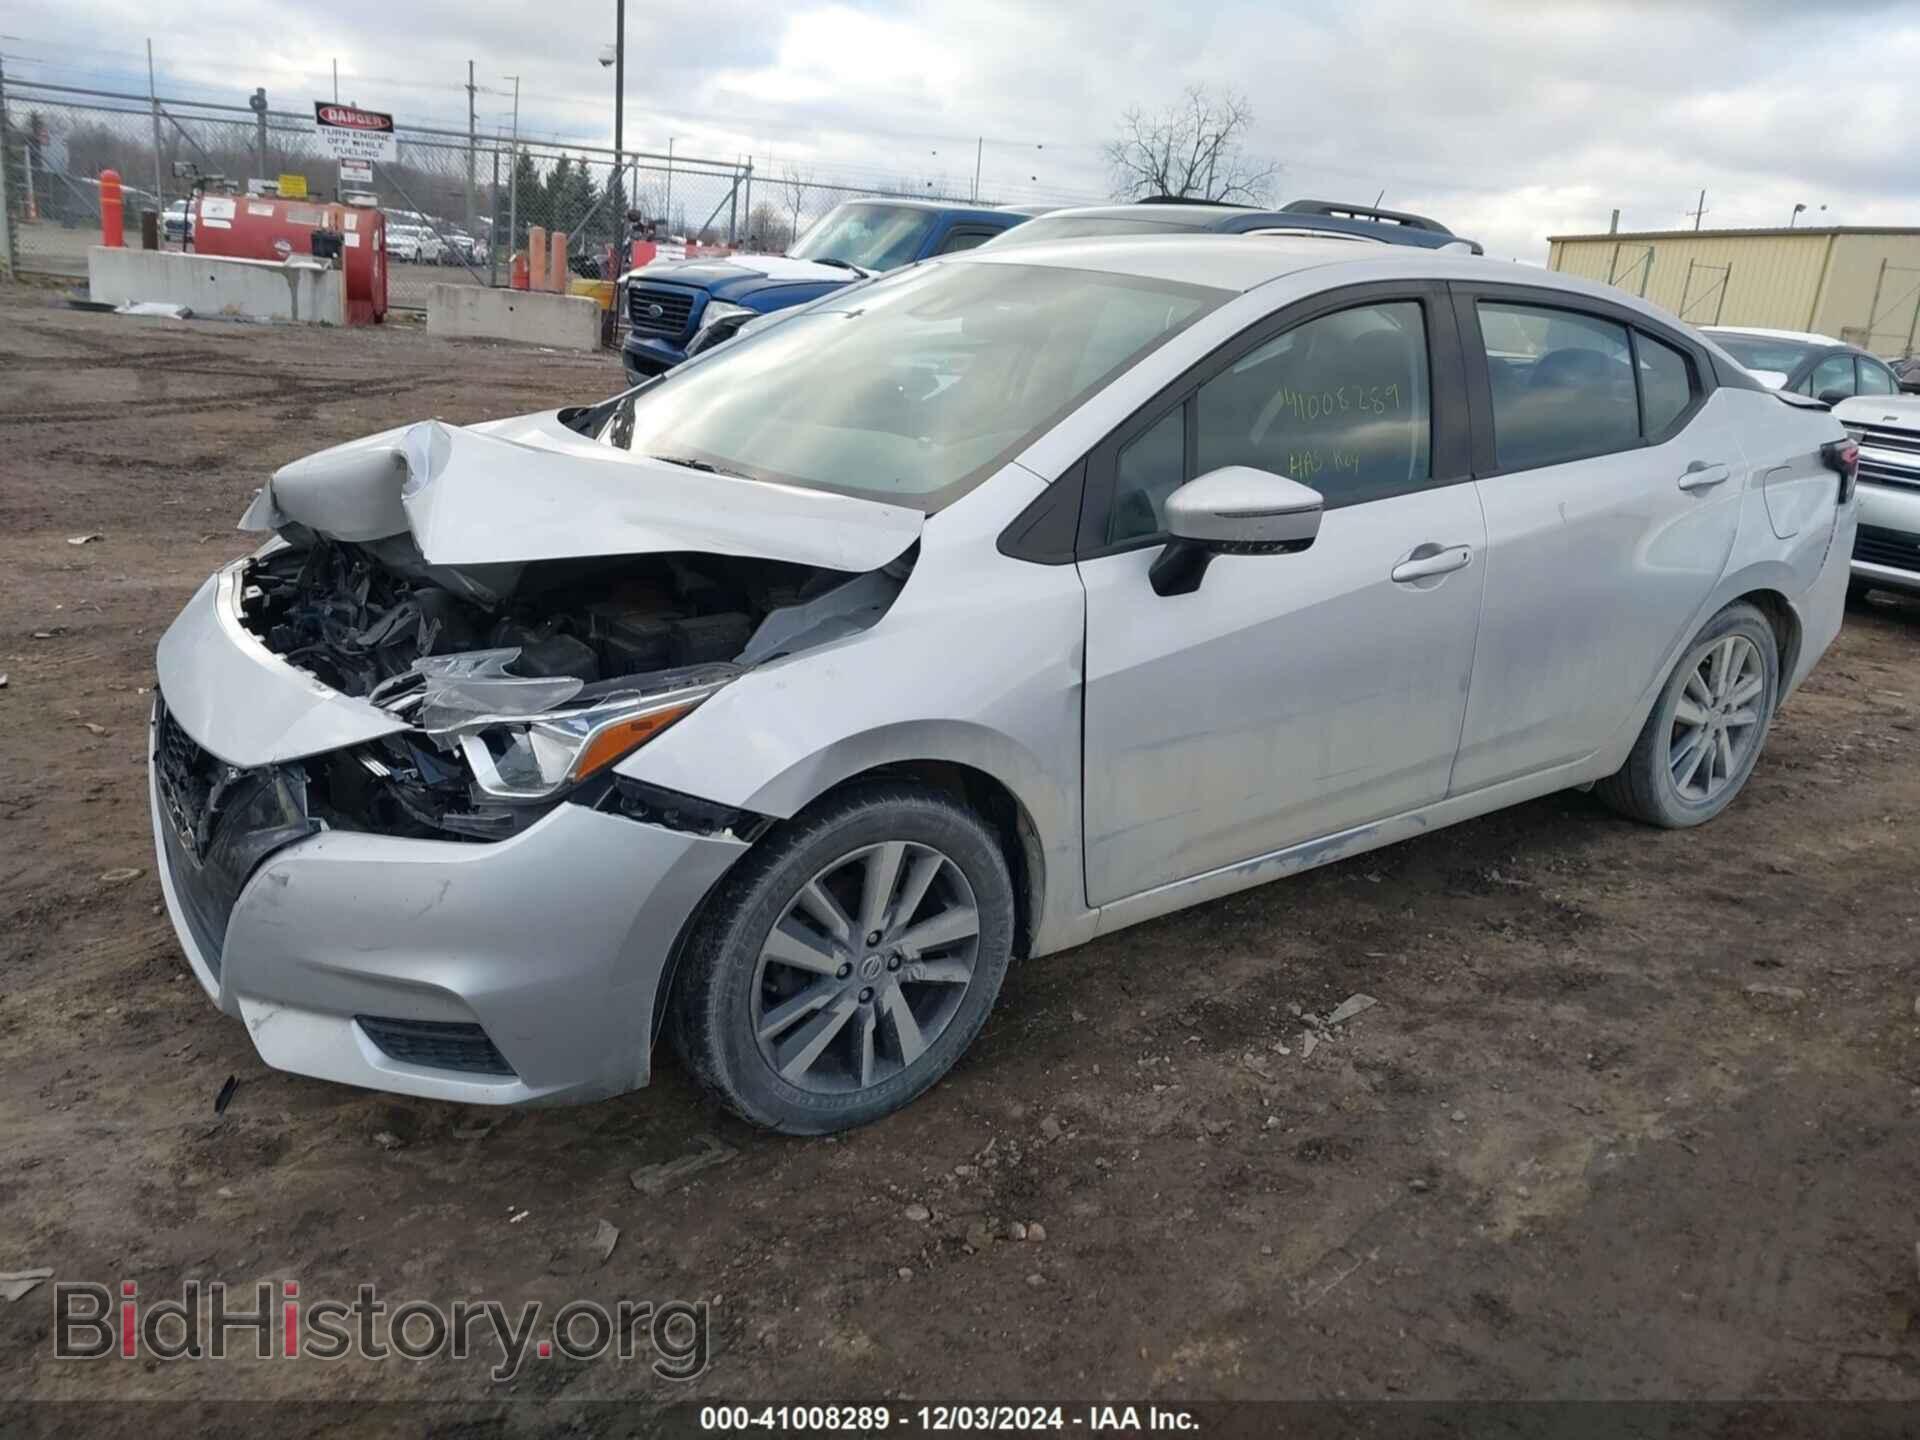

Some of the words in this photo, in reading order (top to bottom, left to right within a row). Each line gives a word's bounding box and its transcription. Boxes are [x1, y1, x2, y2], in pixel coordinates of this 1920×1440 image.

[328, 109, 381, 126] DANGER
[321, 128, 350, 138] TURN
[352, 131, 391, 142] ENGINE
[327, 137, 349, 145] OFF
[352, 140, 385, 150] WHILE
[333, 146, 380, 158] FUELING
